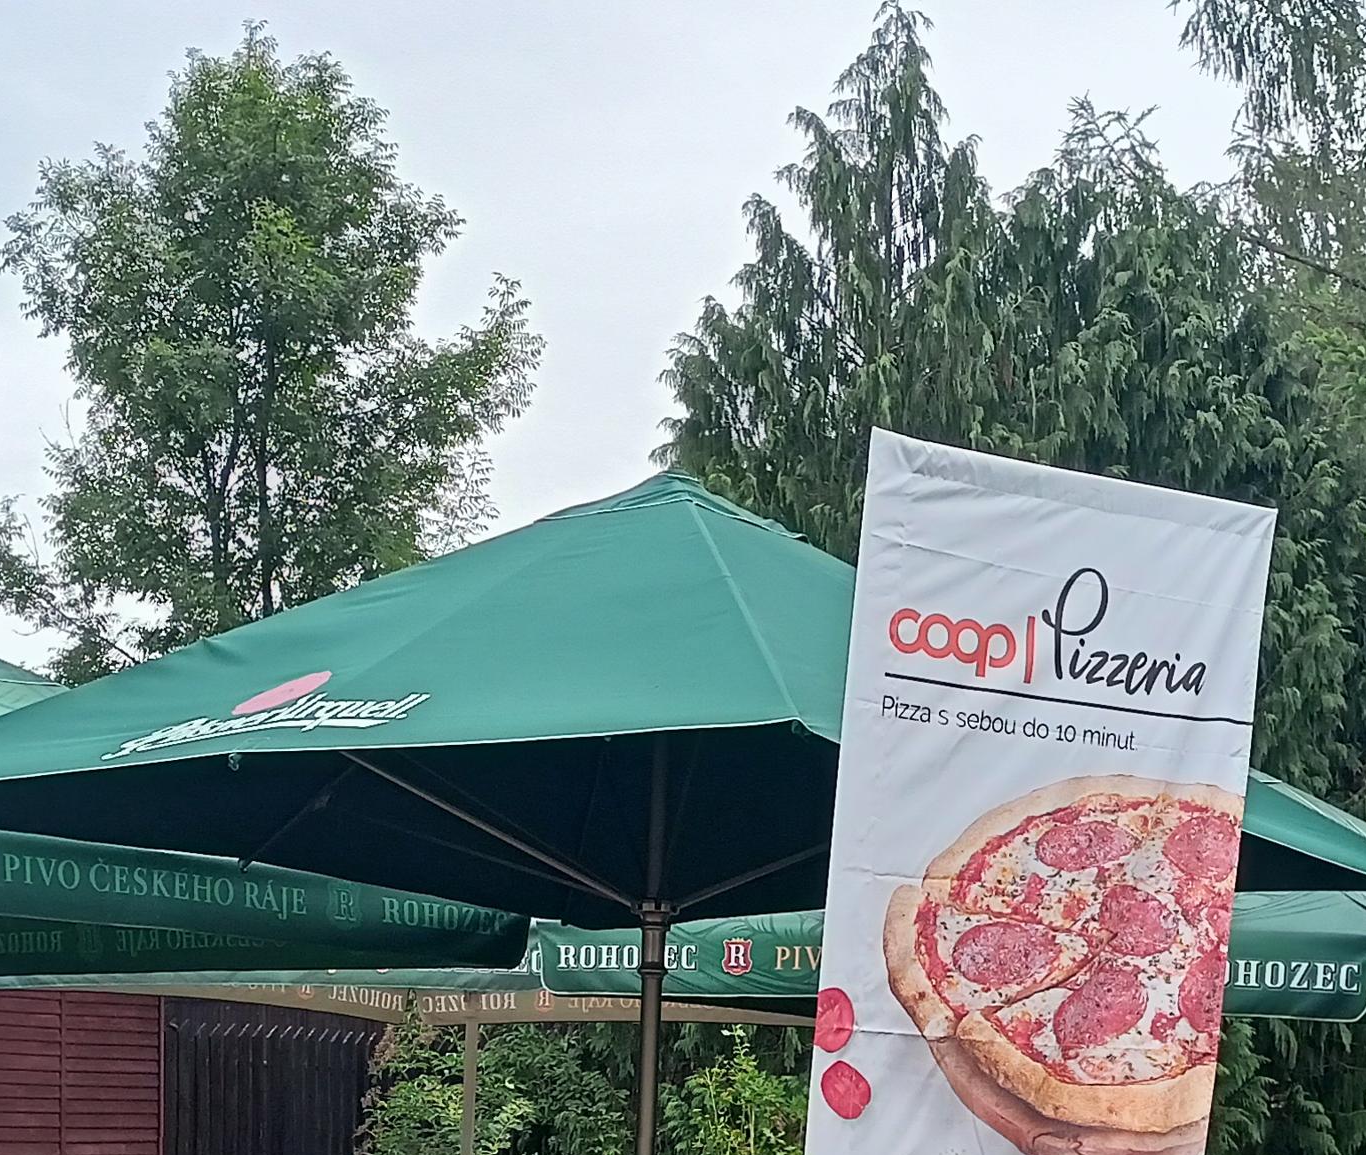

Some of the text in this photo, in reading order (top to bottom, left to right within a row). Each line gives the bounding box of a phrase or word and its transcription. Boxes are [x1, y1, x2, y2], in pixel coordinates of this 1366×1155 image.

[889, 567, 1208, 697] coop Pizzeria
[881, 694, 931, 724] Pizza
[938, 706, 949, 726] s
[955, 709, 1016, 737] sebou
[1022, 717, 1049, 739] do
[1055, 724, 1076, 743] 10
[3, 853, 81, 889] PIVO
[89, 858, 235, 906] ČESKÉHO
[243, 879, 307, 921] RÁJE
[557, 944, 698, 971] ROHOEC
[1224, 960, 1360, 992] HOZEC
